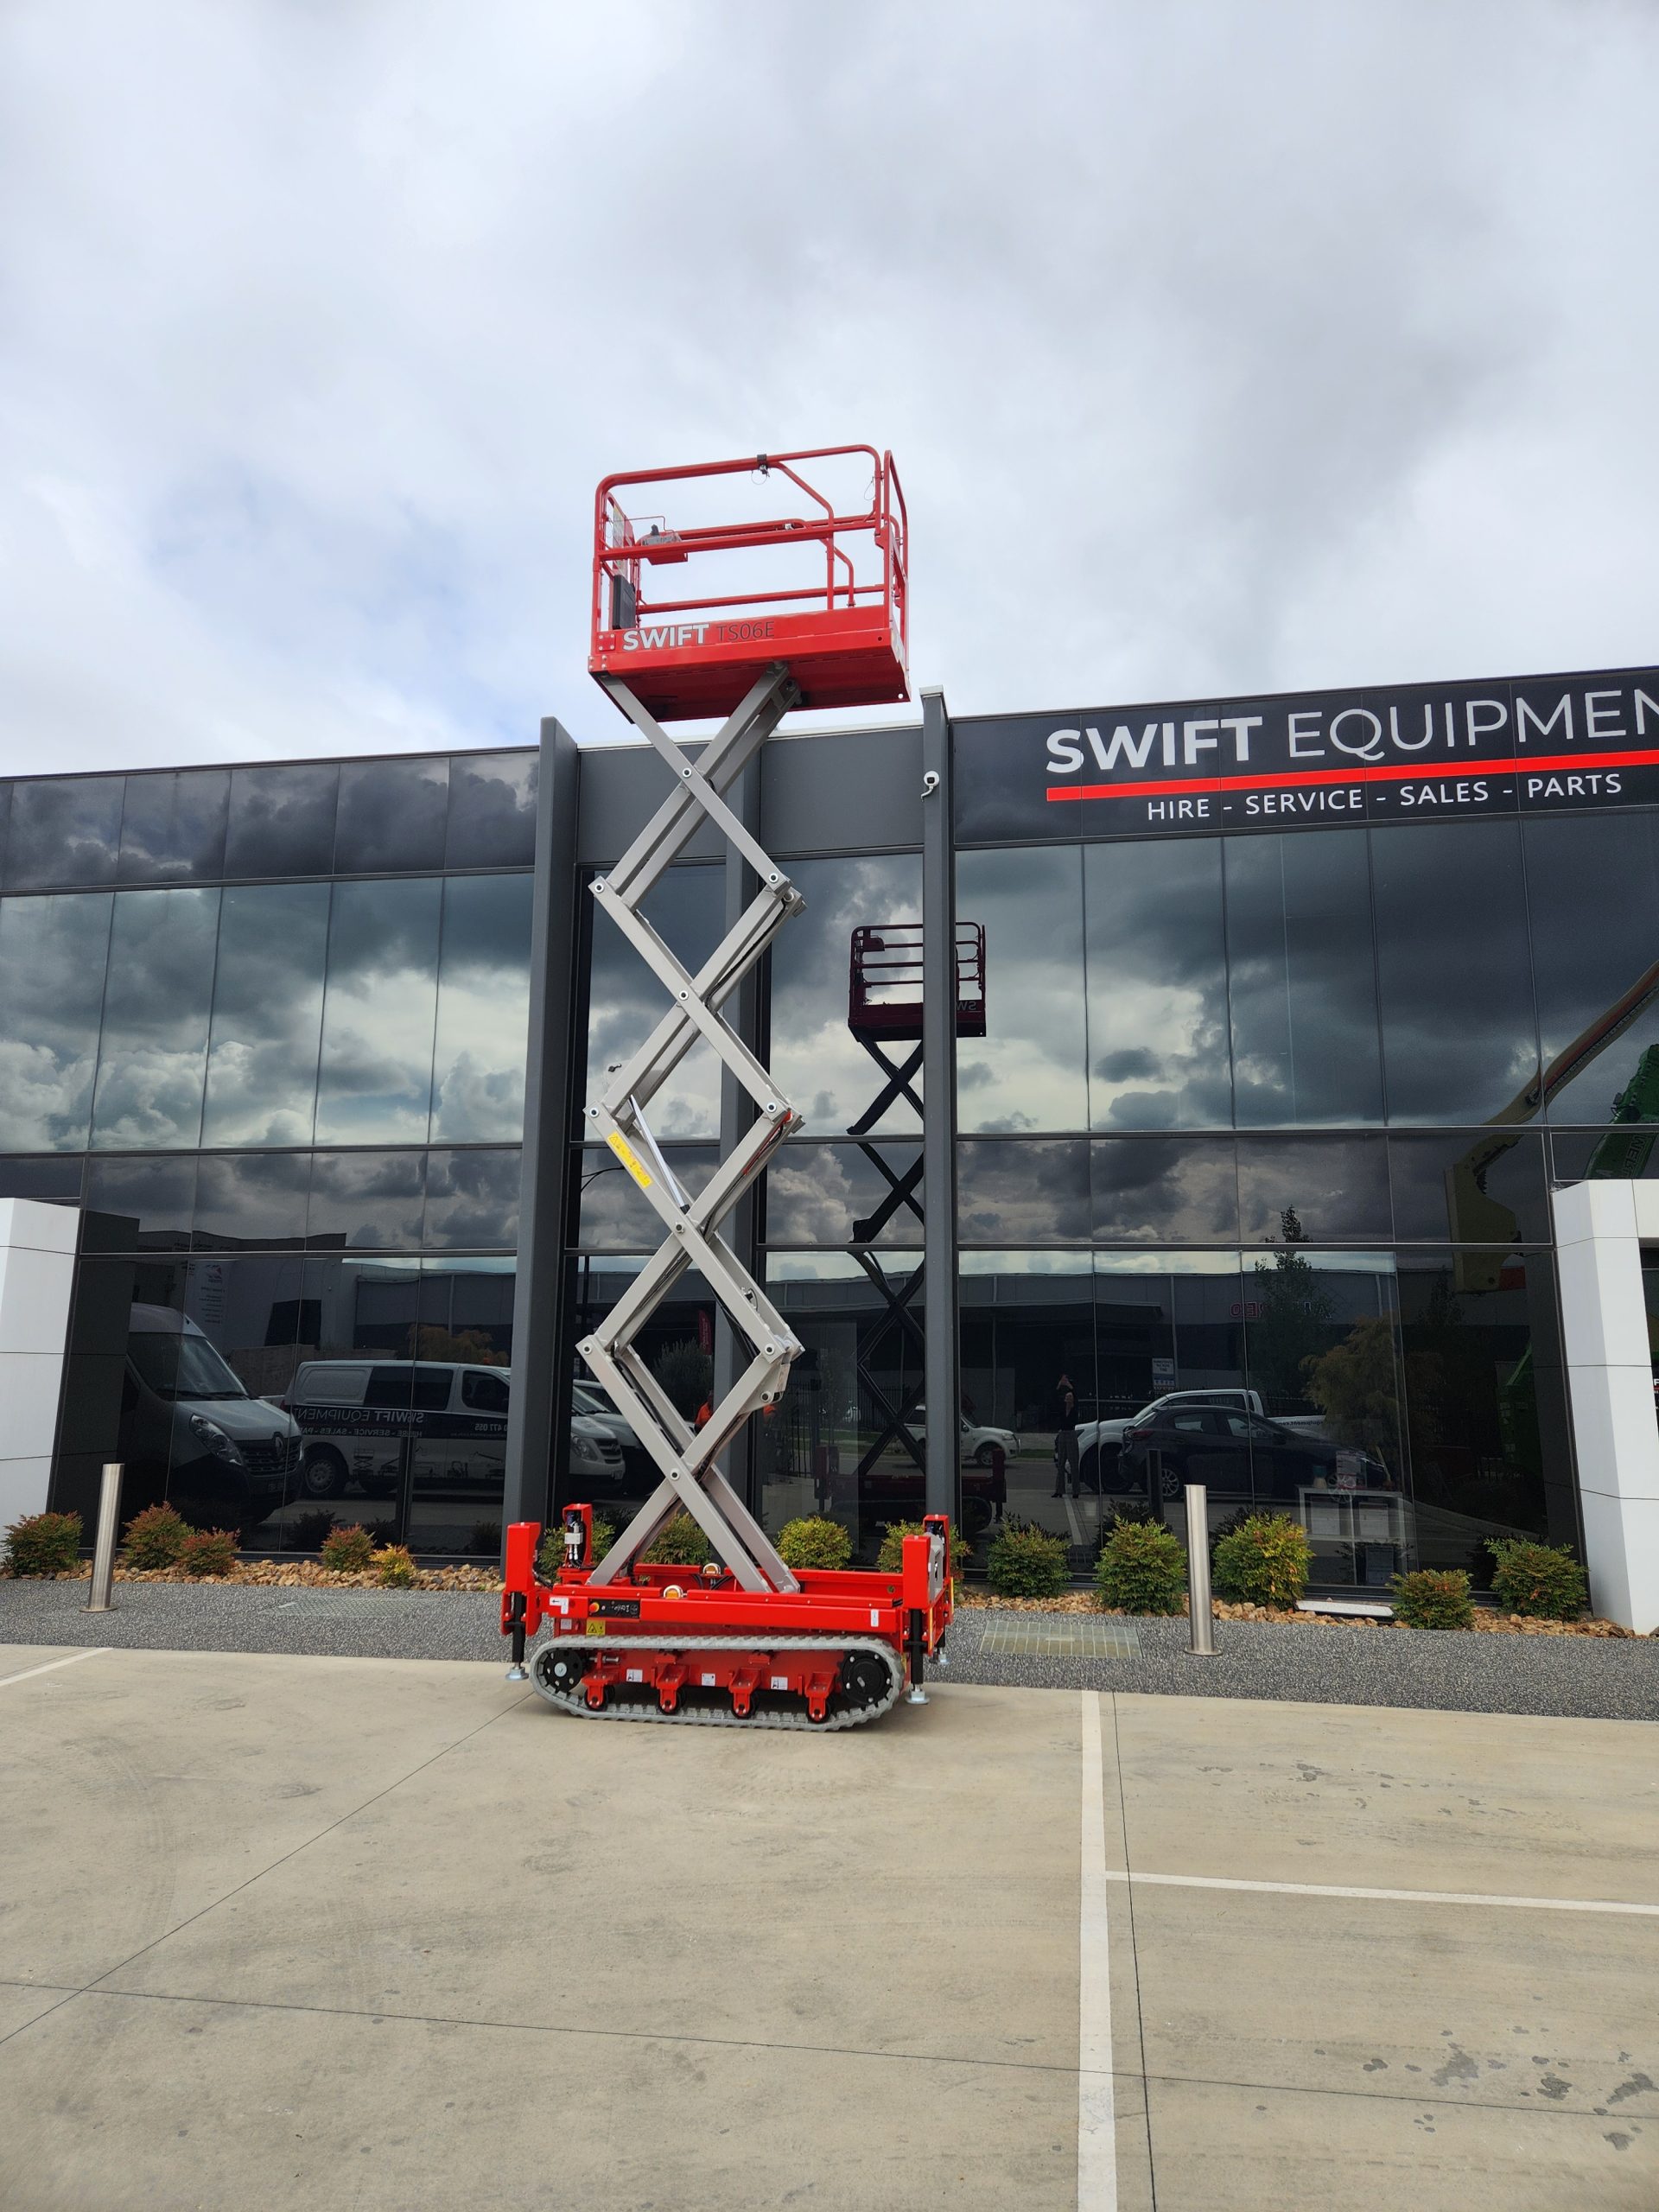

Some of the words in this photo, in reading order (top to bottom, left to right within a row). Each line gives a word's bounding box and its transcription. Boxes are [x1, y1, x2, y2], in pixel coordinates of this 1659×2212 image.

[622, 623, 709, 652] SWIFT
[716, 621, 775, 641] TS06E
[1046, 715, 1263, 773] SWIFT
[1147, 798, 1211, 821] HIRE
[1245, 789, 1363, 815] SERVICE
[1400, 781, 1489, 806] SALES
[1528, 773, 1623, 798] PARTS
